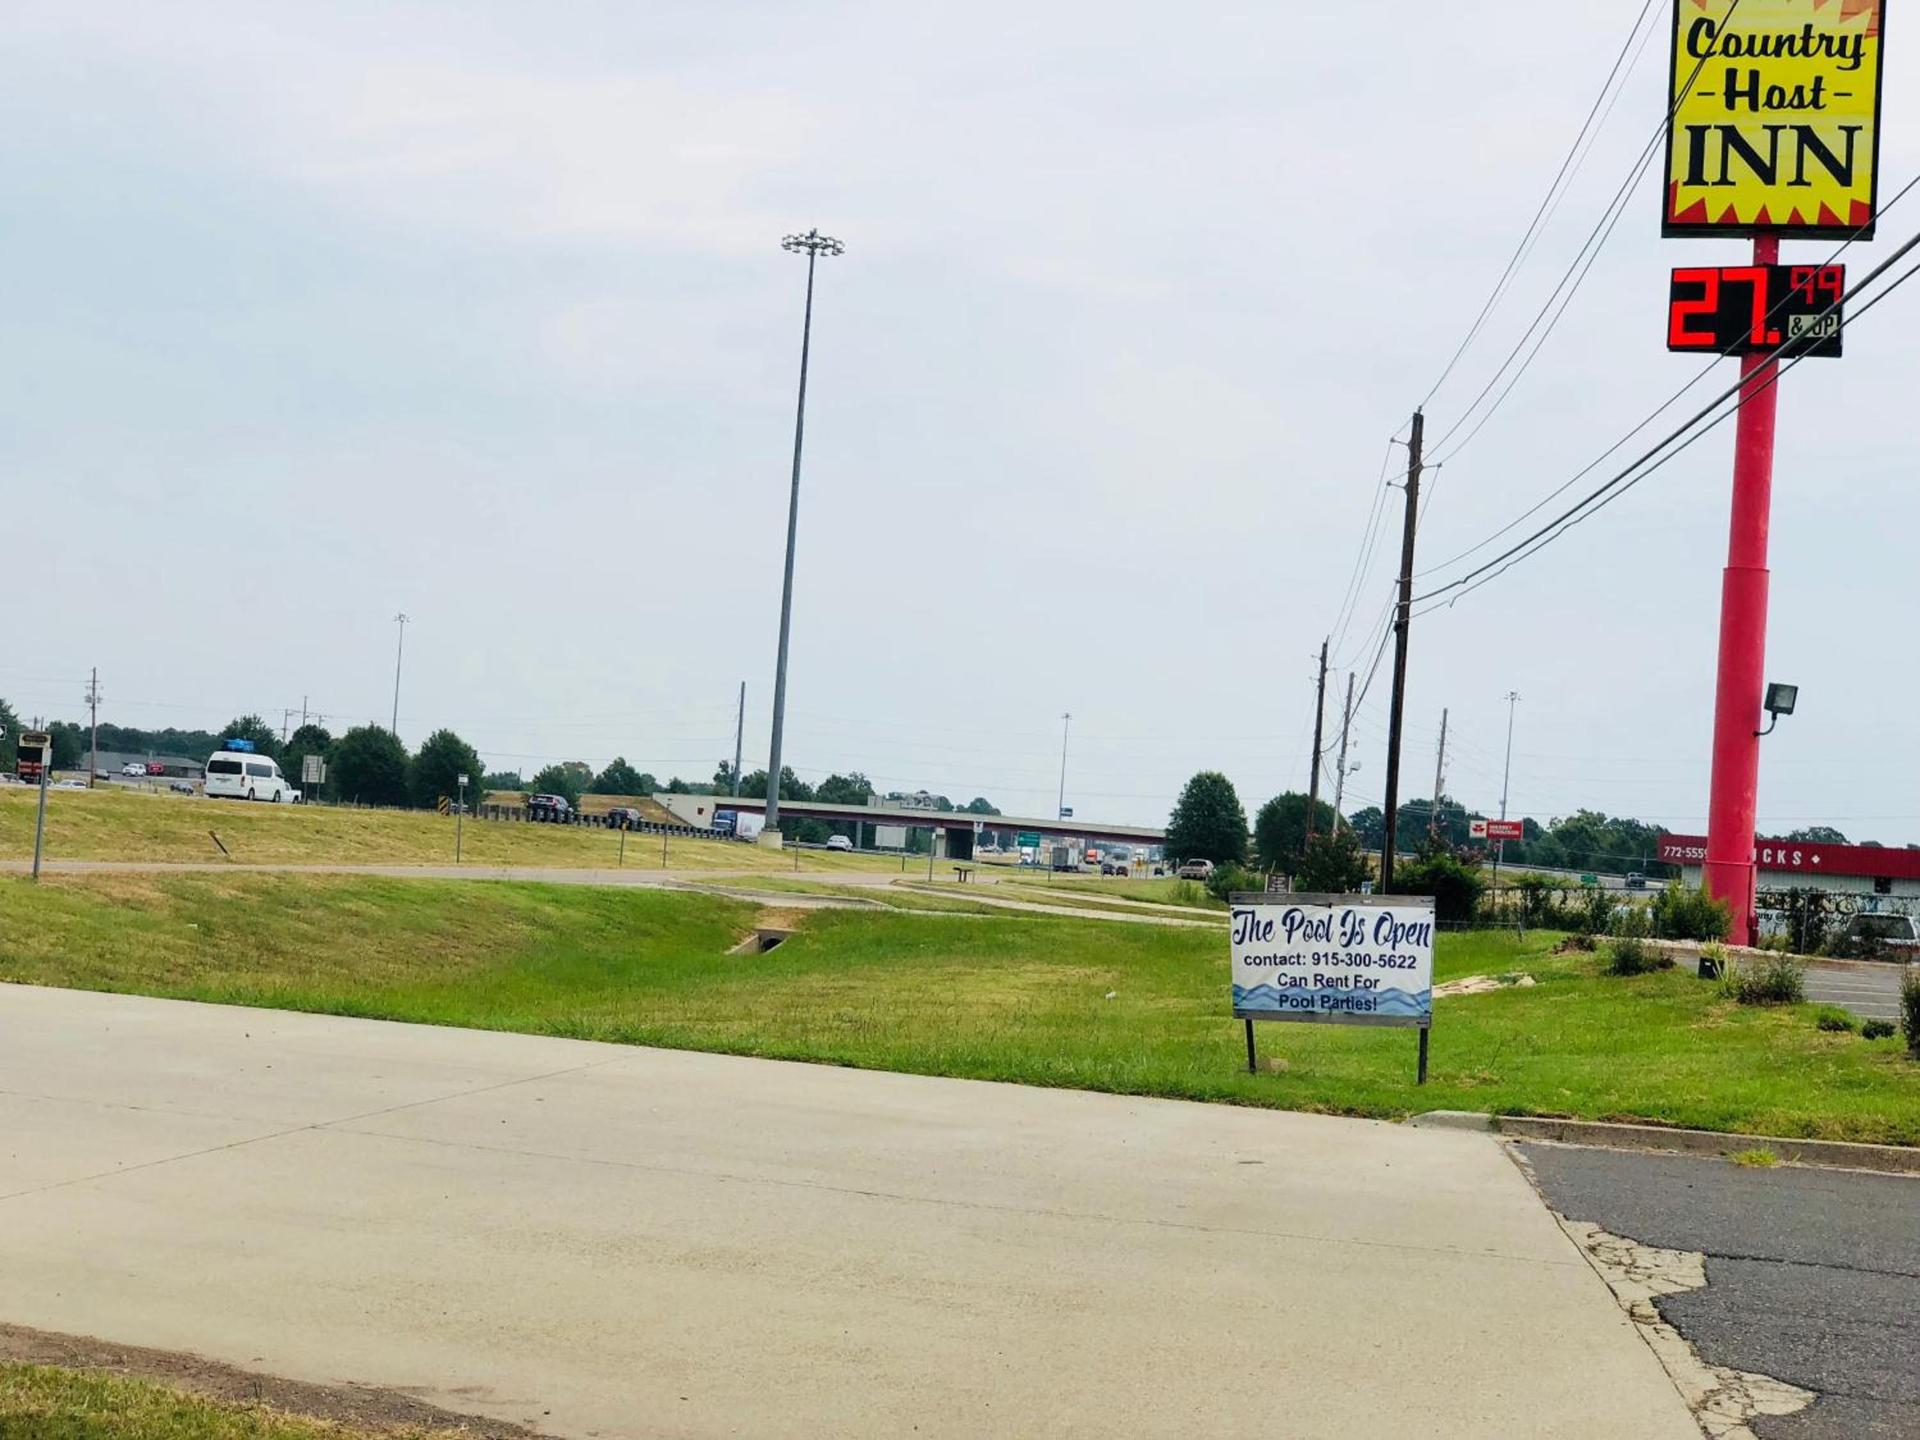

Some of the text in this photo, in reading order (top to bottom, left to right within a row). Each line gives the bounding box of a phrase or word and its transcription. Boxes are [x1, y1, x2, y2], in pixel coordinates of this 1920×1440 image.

[1686, 17, 1866, 71] Country
[1723, 68, 1827, 112] Host
[1682, 124, 1863, 187] INN
[1790, 266, 1842, 304] 99
[1791, 316, 1803, 336] &
[1753, 847, 1802, 865] CKS
[1232, 908, 1431, 950] The Pool Is Open
[1244, 952, 1417, 969] contact: 915-300-5622
[1277, 973, 1380, 989] Can Rent For
[1278, 994, 1377, 1011] Pool Parties!
